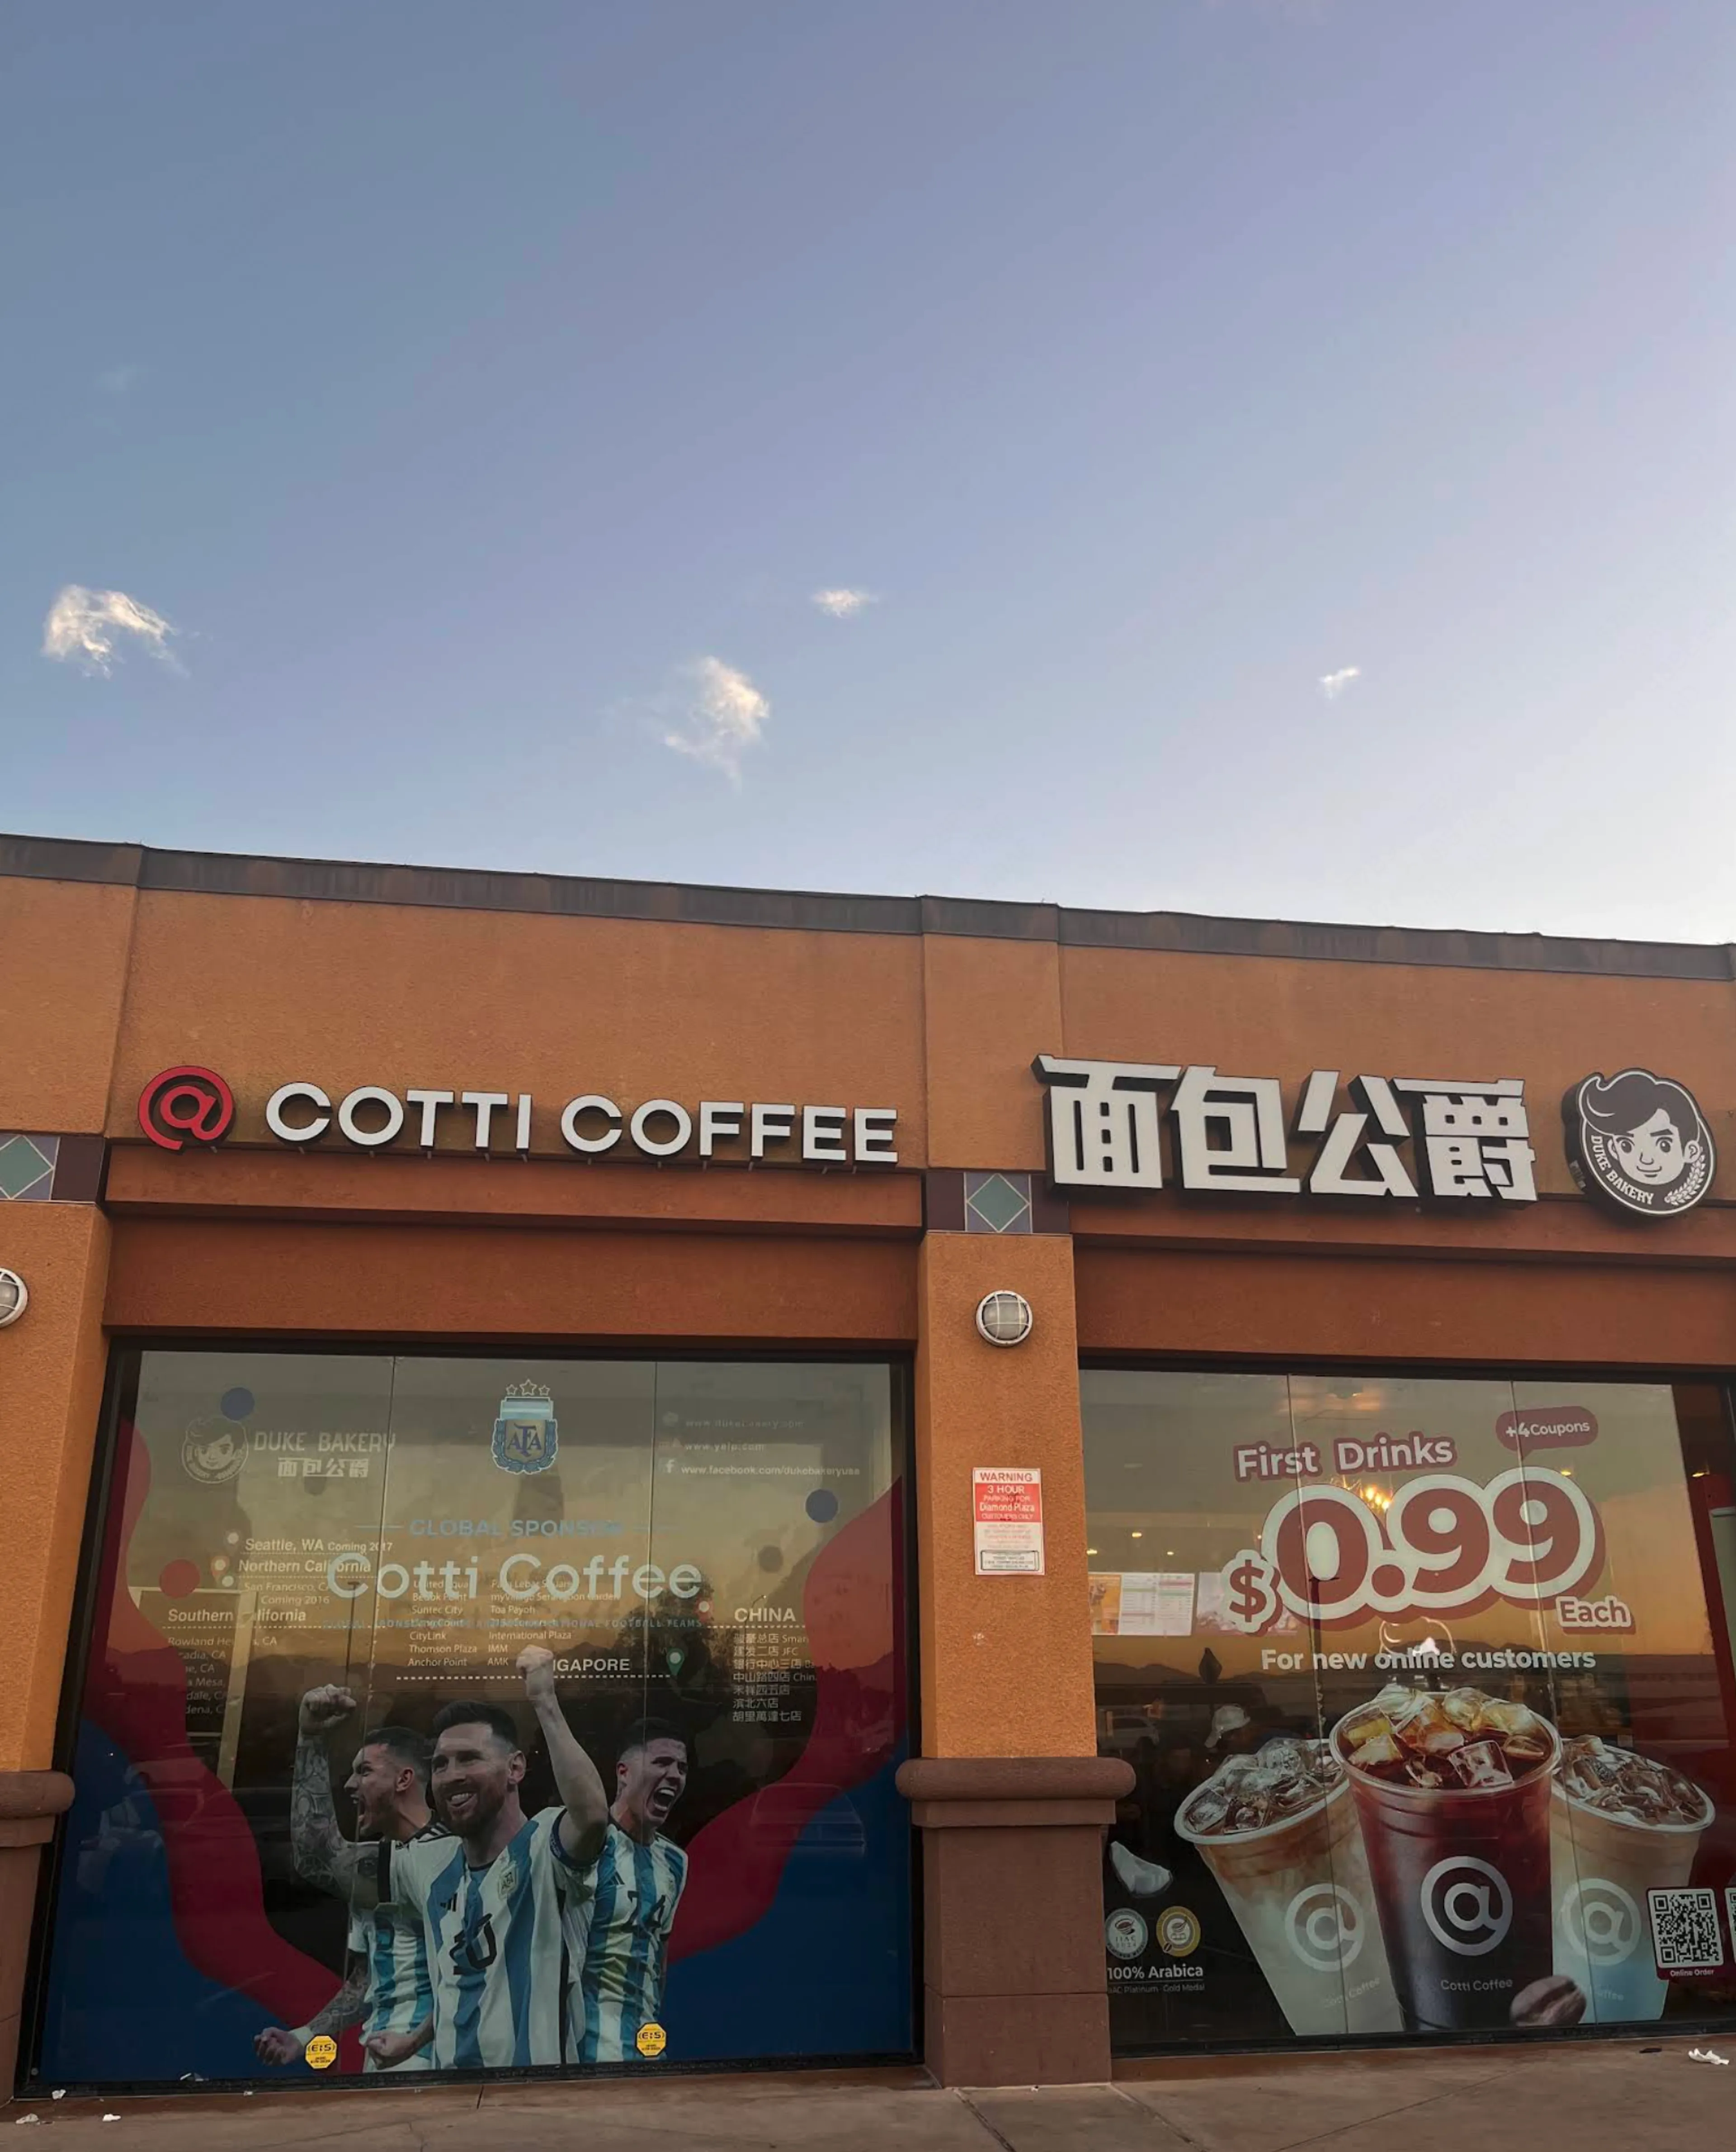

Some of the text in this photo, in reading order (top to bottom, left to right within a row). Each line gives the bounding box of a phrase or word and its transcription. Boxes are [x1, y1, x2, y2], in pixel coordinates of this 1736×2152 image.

[266, 1082, 532, 1151] COTTI
[561, 1094, 898, 1163] COFFEE
[1033, 1054, 1538, 1201] 面包公爵
[1590, 1135, 1655, 1205] DUKE BAKERY
[254, 1431, 396, 1453] DUKE BAKERY
[1238, 1436, 1453, 1478] First Drinks
[980, 1472, 1033, 1482] WARNING
[987, 1484, 1025, 1494] 3 HOUR
[980, 1502, 1035, 1512] Diamond Plaza
[410, 1519, 505, 1537] GLOBAL
[245, 1538, 297, 1552] Seattle,
[302, 1538, 324, 1551] WA
[328, 1541, 367, 1555] Coming
[239, 1559, 371, 1573] Northern Calornia
[327, 1552, 703, 1600] Cotti Coffee
[244, 1582, 262, 1592] San
[260, 1595, 330, 1607] Coming 2016
[168, 1609, 234, 1622] Southern
[412, 1605, 463, 1616] Suntec City
[491, 1605, 506, 1614] Toa
[734, 1607, 796, 1623] CHINA
[1559, 1600, 1627, 1624] Each
[168, 1636, 214, 1646] Rowland
[262, 1636, 278, 1646] CA
[410, 1631, 447, 1643] CityLink
[488, 1630, 572, 1640] International Plaza
[212, 1650, 226, 1659] CA
[408, 1644, 477, 1653] Thomson Plaza
[488, 1644, 508, 1653] IMM
[407, 1657, 468, 1667] Anchor Point
[487, 1657, 509, 1666] AMK
[1261, 1645, 1596, 1670] For new online customers
[200, 1663, 215, 1673] CA
[552, 1658, 631, 1672] GAPORE
[793, 1672, 816, 1681] Chin
[1107, 1963, 1203, 1980] 100% Arabica
[1670, 1968, 1714, 1978] Online Order
[1440, 1978, 1513, 1991] Cotti Coffee
